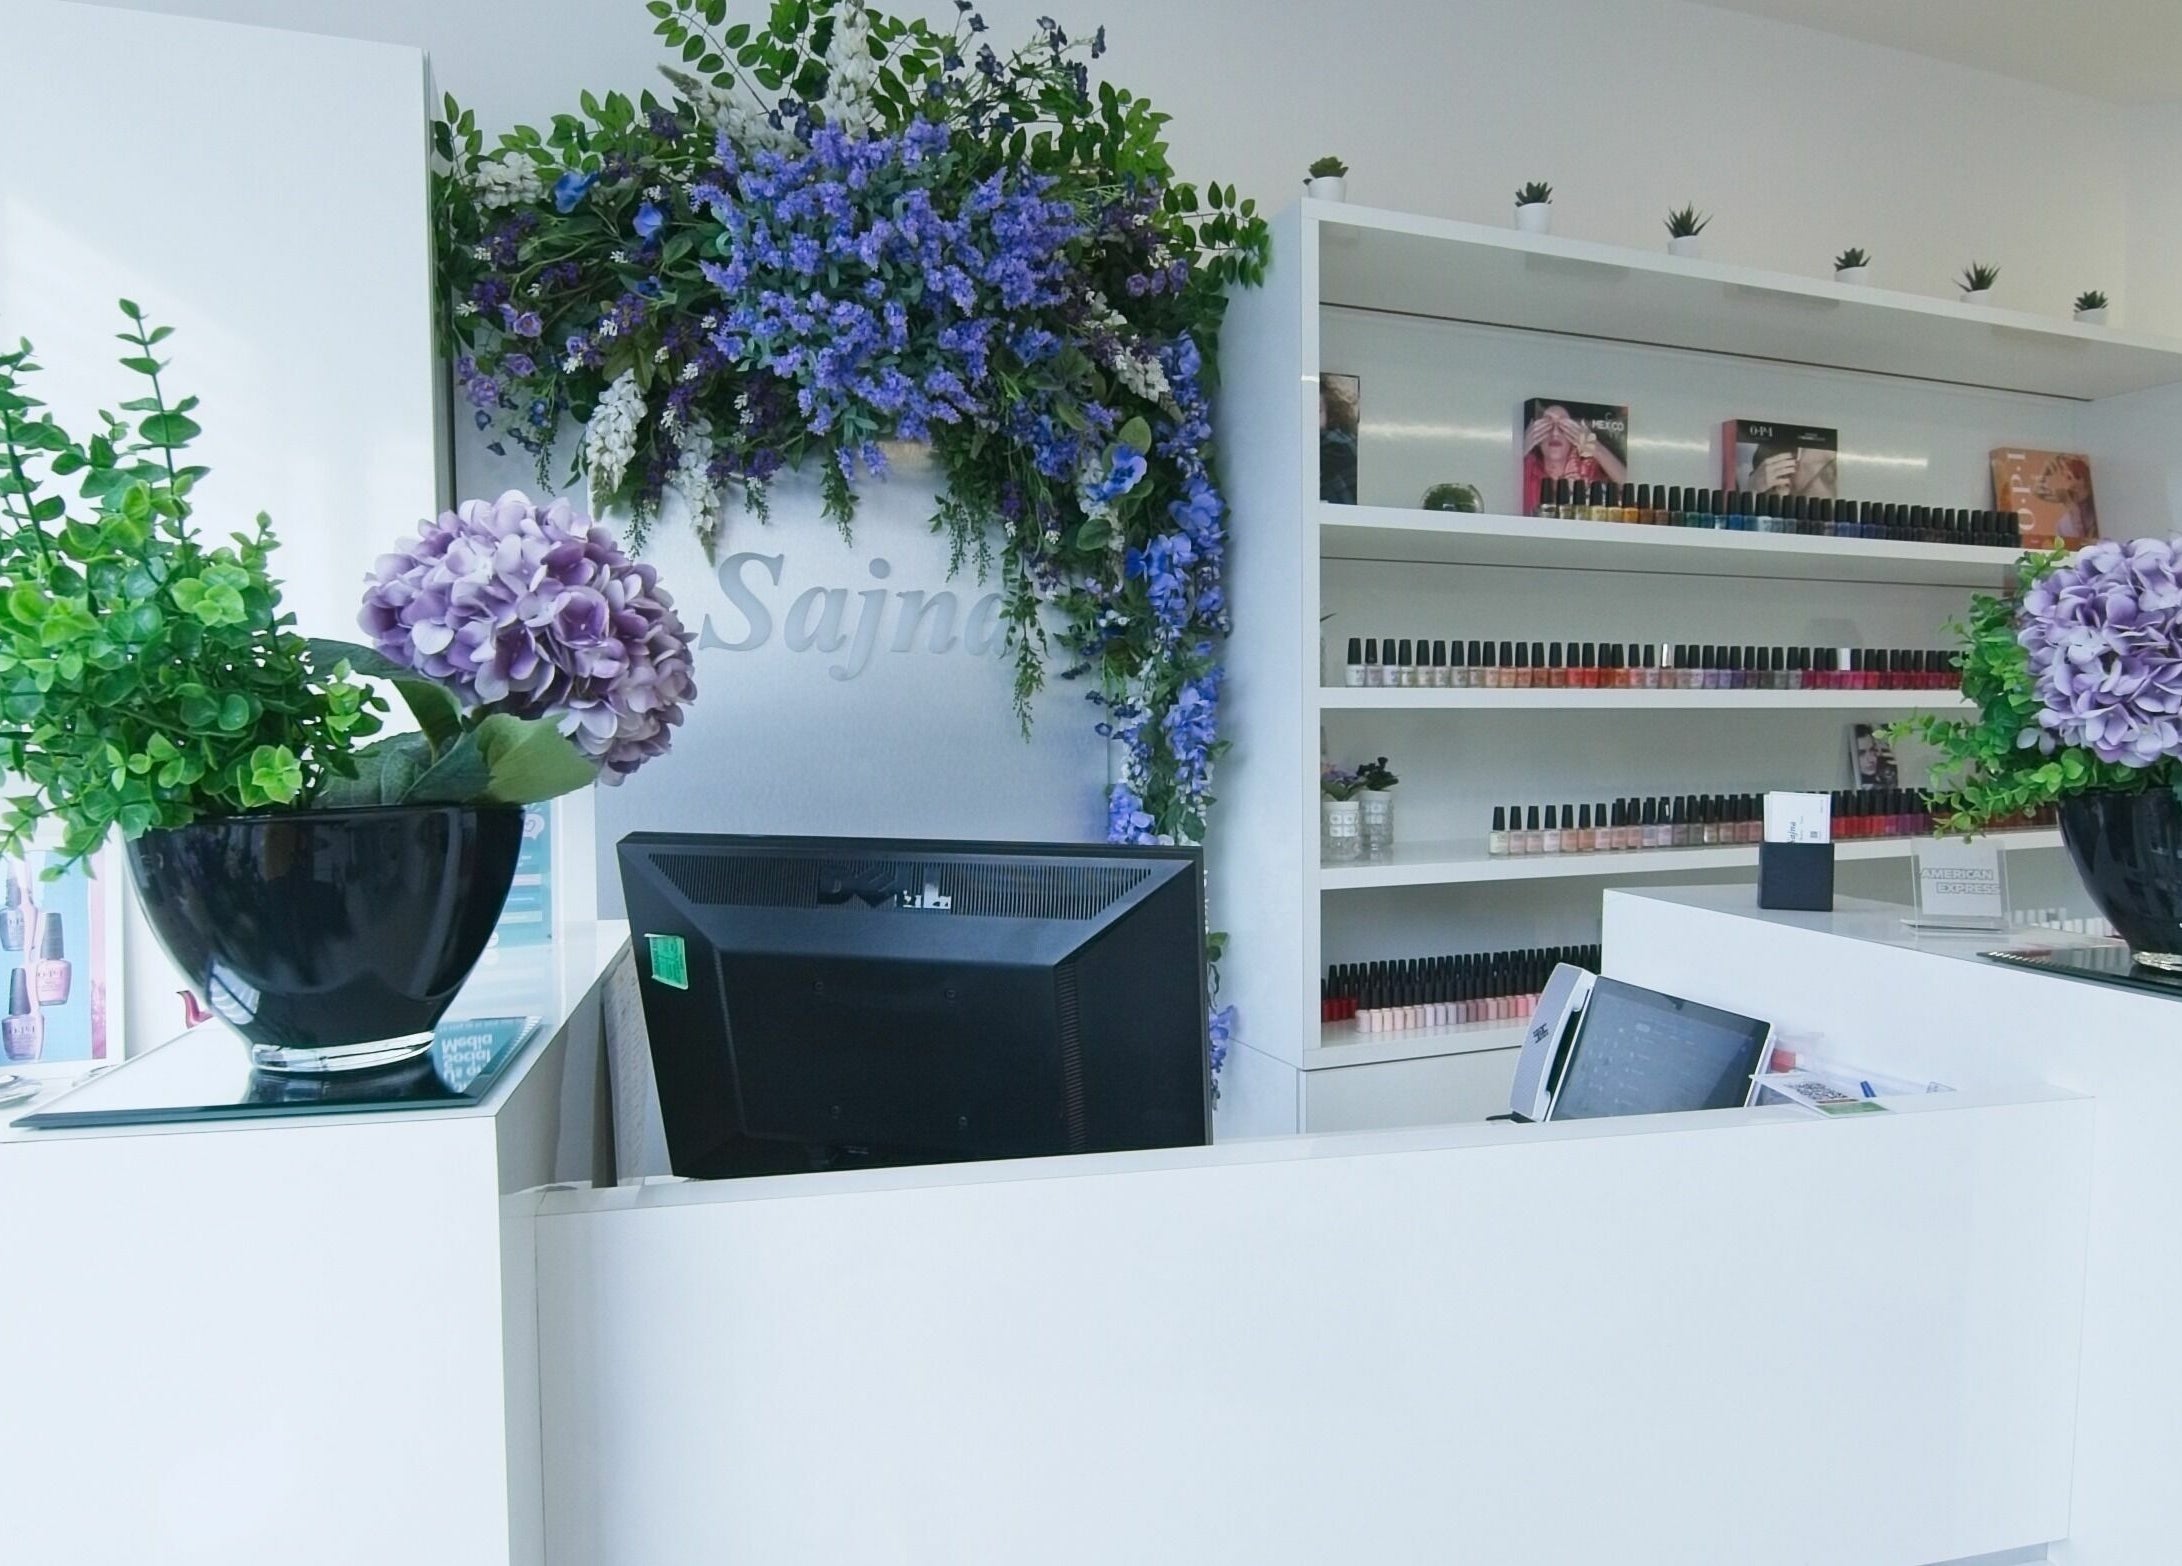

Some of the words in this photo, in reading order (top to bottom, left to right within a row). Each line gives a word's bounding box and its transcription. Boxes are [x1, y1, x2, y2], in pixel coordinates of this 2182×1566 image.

[1592, 419, 1625, 432] MEXCO
[698, 551, 1016, 682] Sajna
[1920, 867, 1993, 880] AMERICAN
[1936, 881, 2001, 895] EXPRESS
